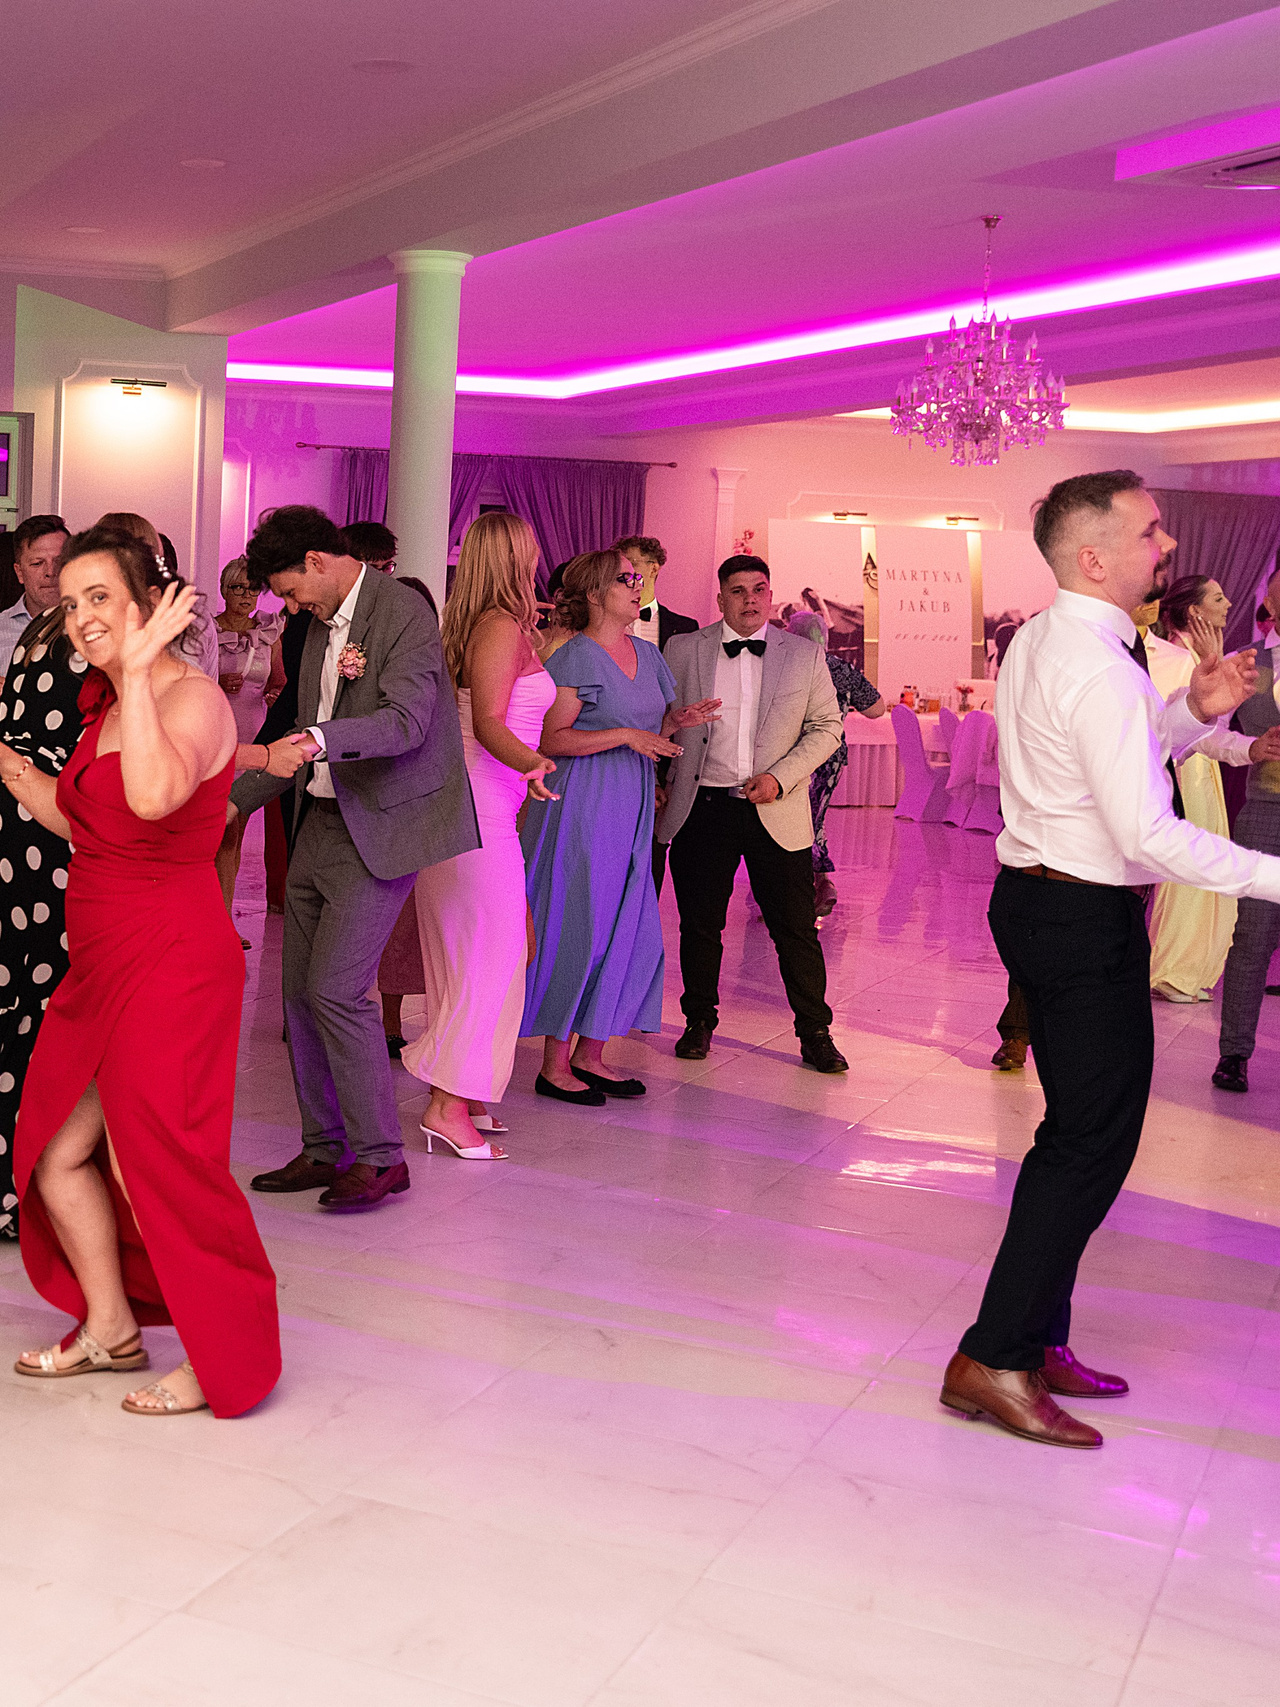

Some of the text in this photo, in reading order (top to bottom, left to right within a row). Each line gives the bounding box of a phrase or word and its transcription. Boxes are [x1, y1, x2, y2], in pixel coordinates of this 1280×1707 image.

[885, 569, 962, 583] MARTYNA
[922, 587, 929, 596] &
[899, 599, 950, 613] JAKUB
